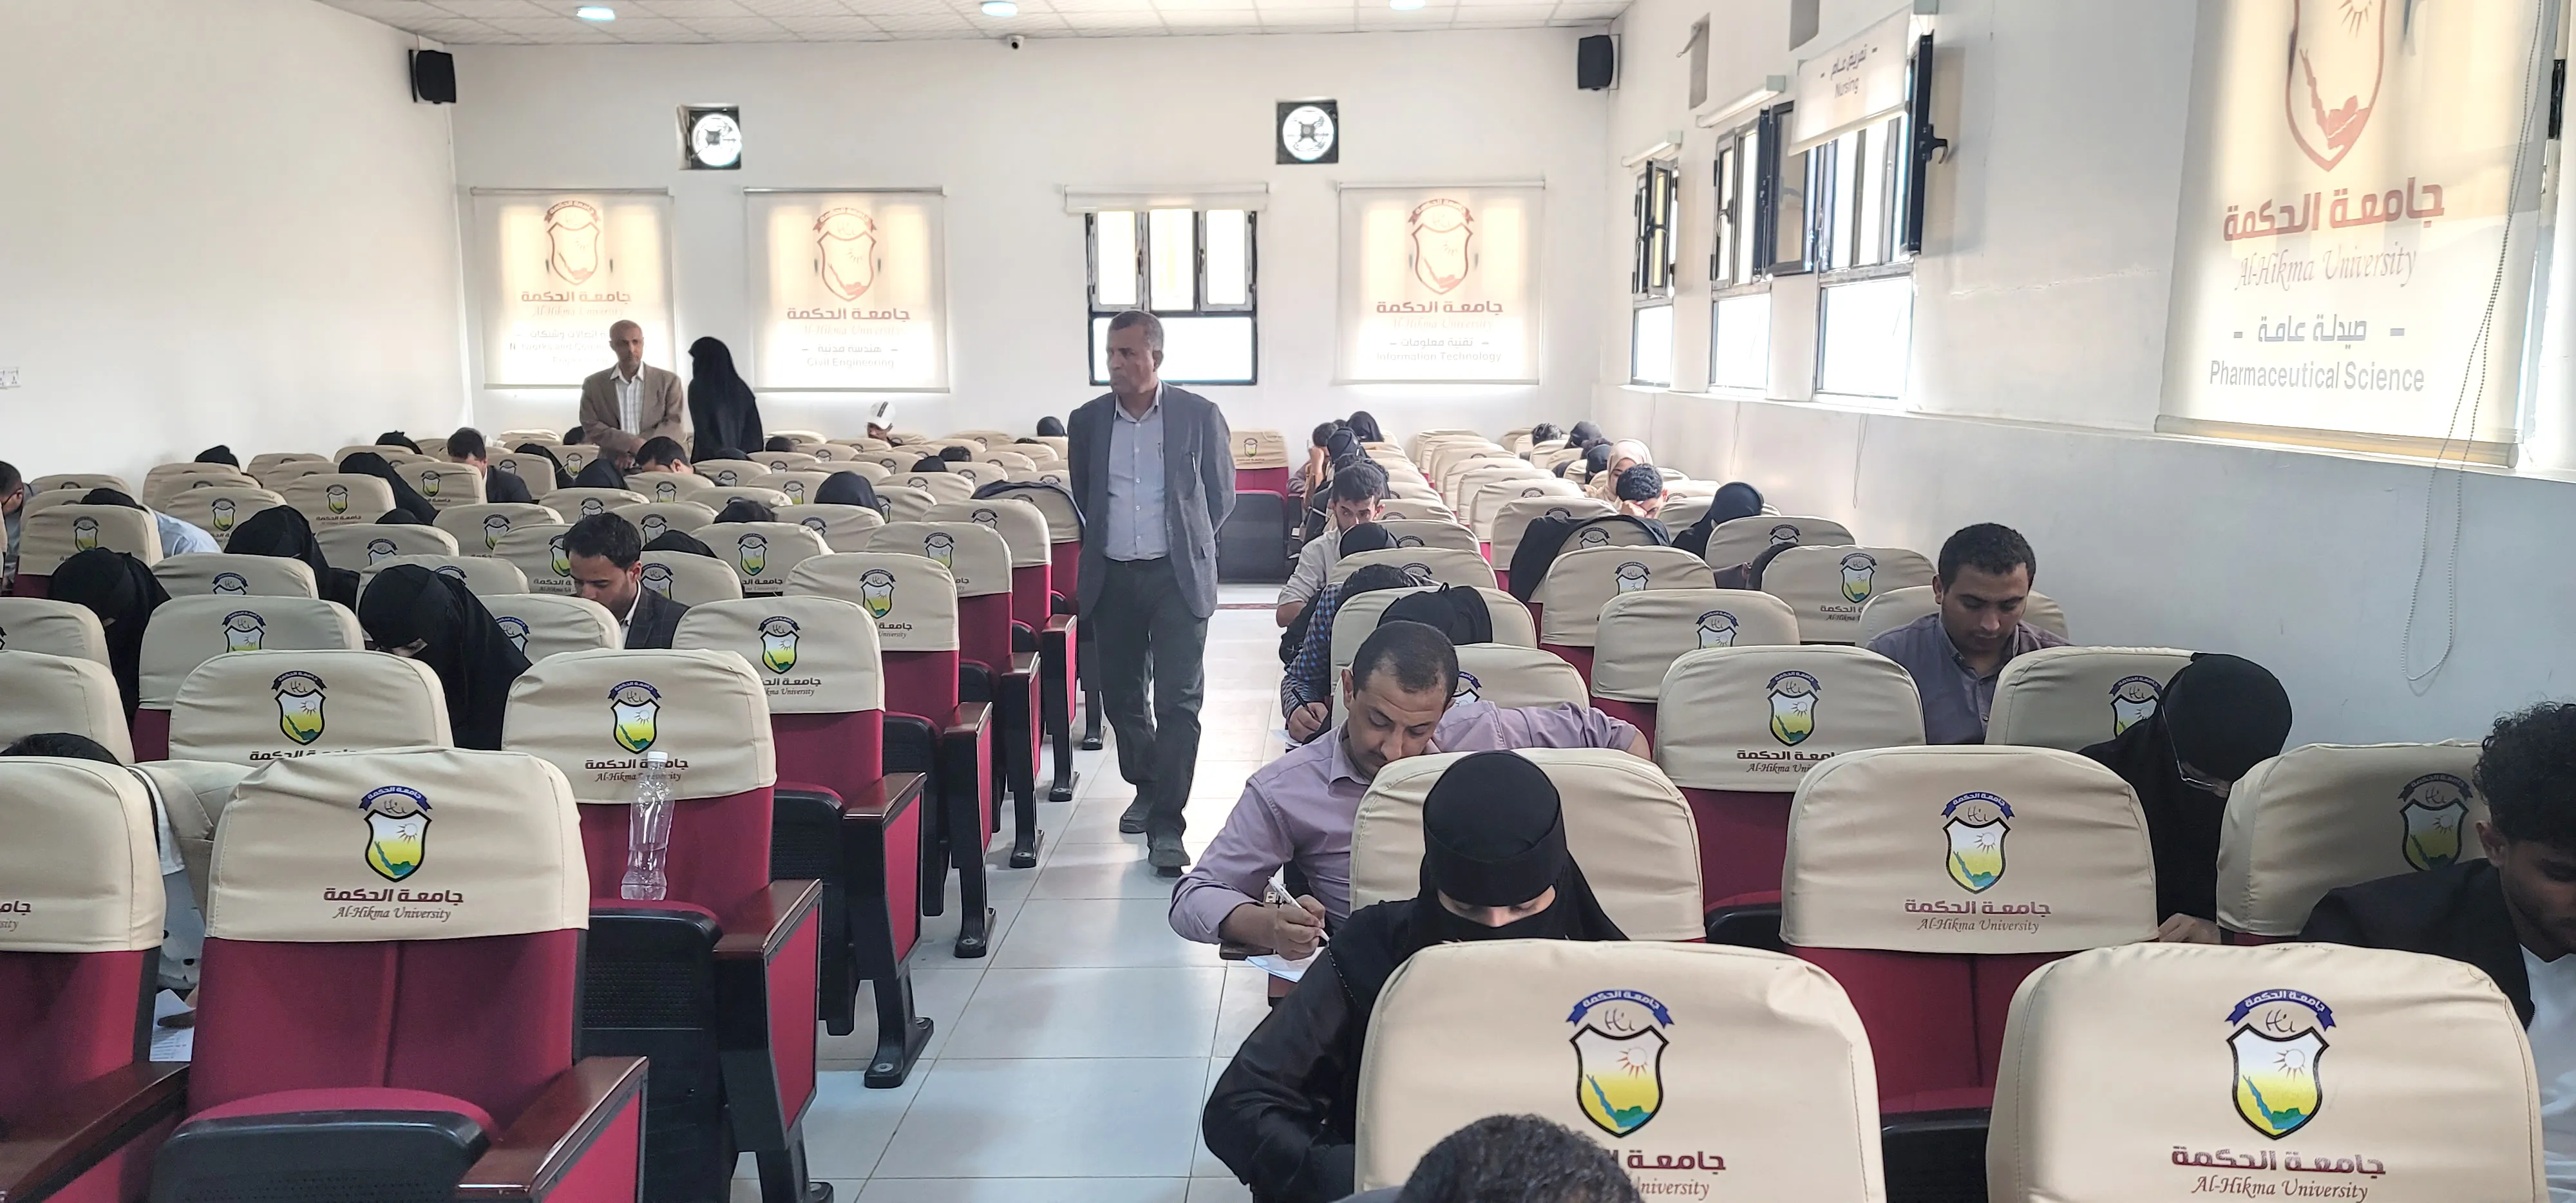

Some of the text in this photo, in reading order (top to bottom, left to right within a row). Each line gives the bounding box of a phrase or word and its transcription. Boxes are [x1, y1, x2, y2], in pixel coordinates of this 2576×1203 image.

[1834, 77, 1859, 98] Nursing
[2224, 177, 2445, 242] جامعة الحكمة
[2234, 242, 2418, 292] Al-Hikma University
[521, 290, 632, 305] جامعة الحكمة
[787, 307, 911, 322] جامعة الحكمة
[1376, 300, 1504, 316] جامعة الحكمة
[2258, 314, 2368, 350] صيدلة عامة
[509, 343, 553, 351] Ntworks
[817, 343, 882, 354] هندسة مدنية
[1400, 337, 1473, 350] تقنية معلومات
[807, 357, 895, 370] Civil Engineering
[1376, 352, 1502, 363] Information Technology
[2210, 359, 2425, 392] Pharmaceutical Science
[878, 622, 913, 631] جامعة
[782, 677, 822, 687] جامعة
[781, 688, 815, 697] University
[249, 750, 304, 761] الحكمة
[1737, 750, 1790, 761] الحكمة
[585, 758, 688, 770] جامة الحكمة
[1747, 763, 1790, 774] Al-Hikma
[595, 772, 637, 782] Al-Hikma
[367, 786, 422, 800] جامعة الحكمة
[1953, 793, 2006, 806] جامعة الحكمة
[323, 887, 464, 906] جامعة الحكمة
[0, 900, 32, 916] جام
[332, 905, 451, 922] Al-Hikma University
[1904, 899, 2052, 918] جامعة الحكمة
[1917, 917, 2039, 934] Al-Hikma University
[1582, 990, 1662, 1010] جامعة الحكمة
[2245, 990, 2325, 1012] جامعة الحكمة
[1627, 1150, 1727, 1175] جامعة
[2172, 1146, 2387, 1179] جامعة الحكمة
[1637, 1176, 1710, 1201] niversity
[2191, 1175, 2368, 1203] Al-Hikma University
